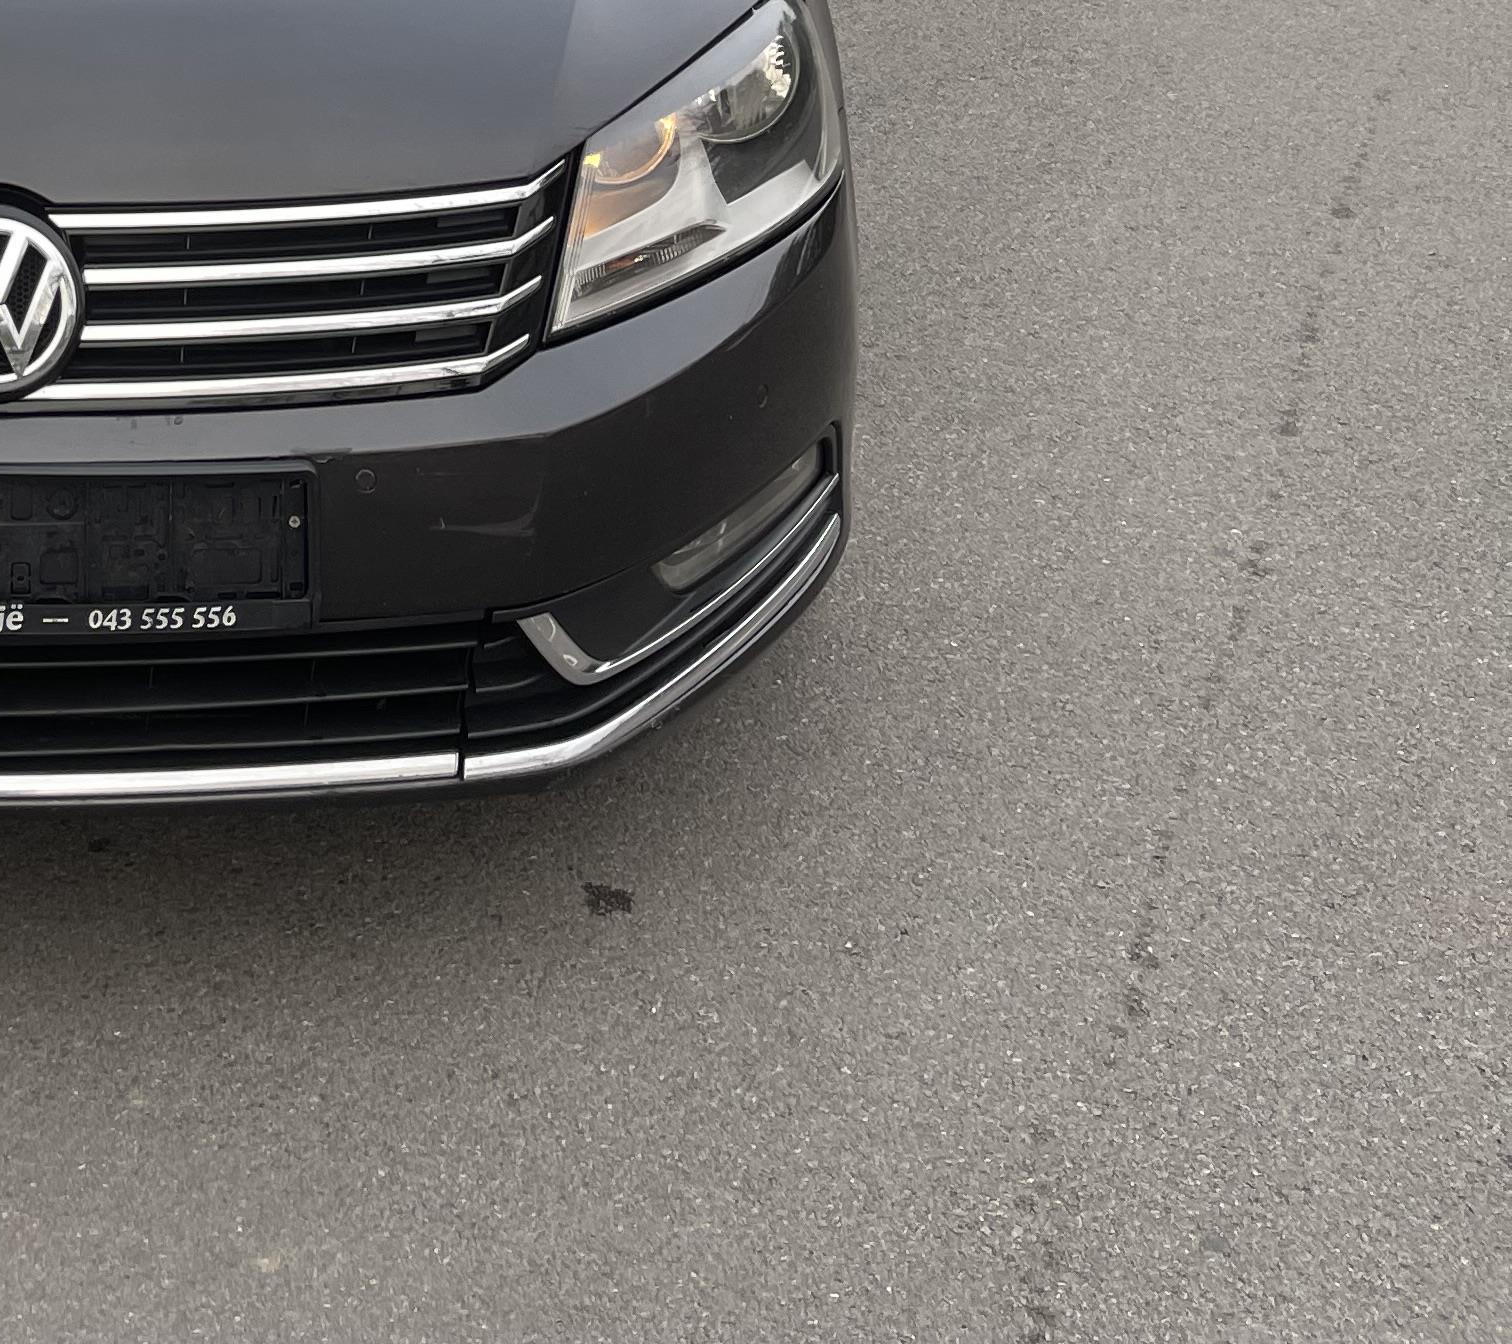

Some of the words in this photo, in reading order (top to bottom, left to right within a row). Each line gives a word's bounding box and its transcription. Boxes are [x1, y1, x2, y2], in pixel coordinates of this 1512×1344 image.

[87, 608, 132, 631] 043
[140, 607, 185, 629] 555
[191, 605, 237, 629] 556
